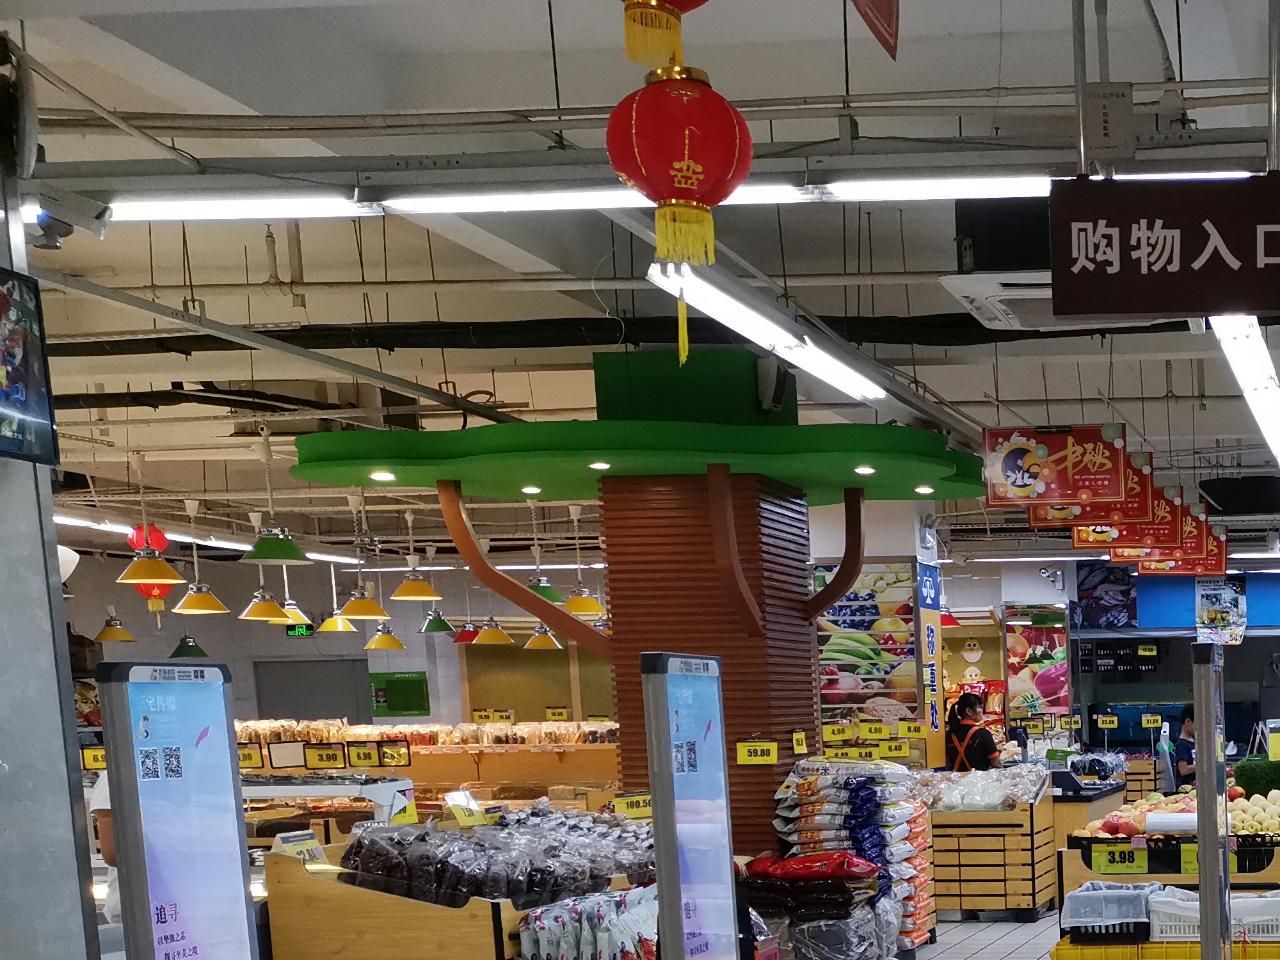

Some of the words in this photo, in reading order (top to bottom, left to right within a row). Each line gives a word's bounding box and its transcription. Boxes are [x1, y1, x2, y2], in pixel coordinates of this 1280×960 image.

[747, 747, 771, 758] 59.80
[1107, 850, 1135, 864] 3.98
[155, 902, 179, 925] 追寻
